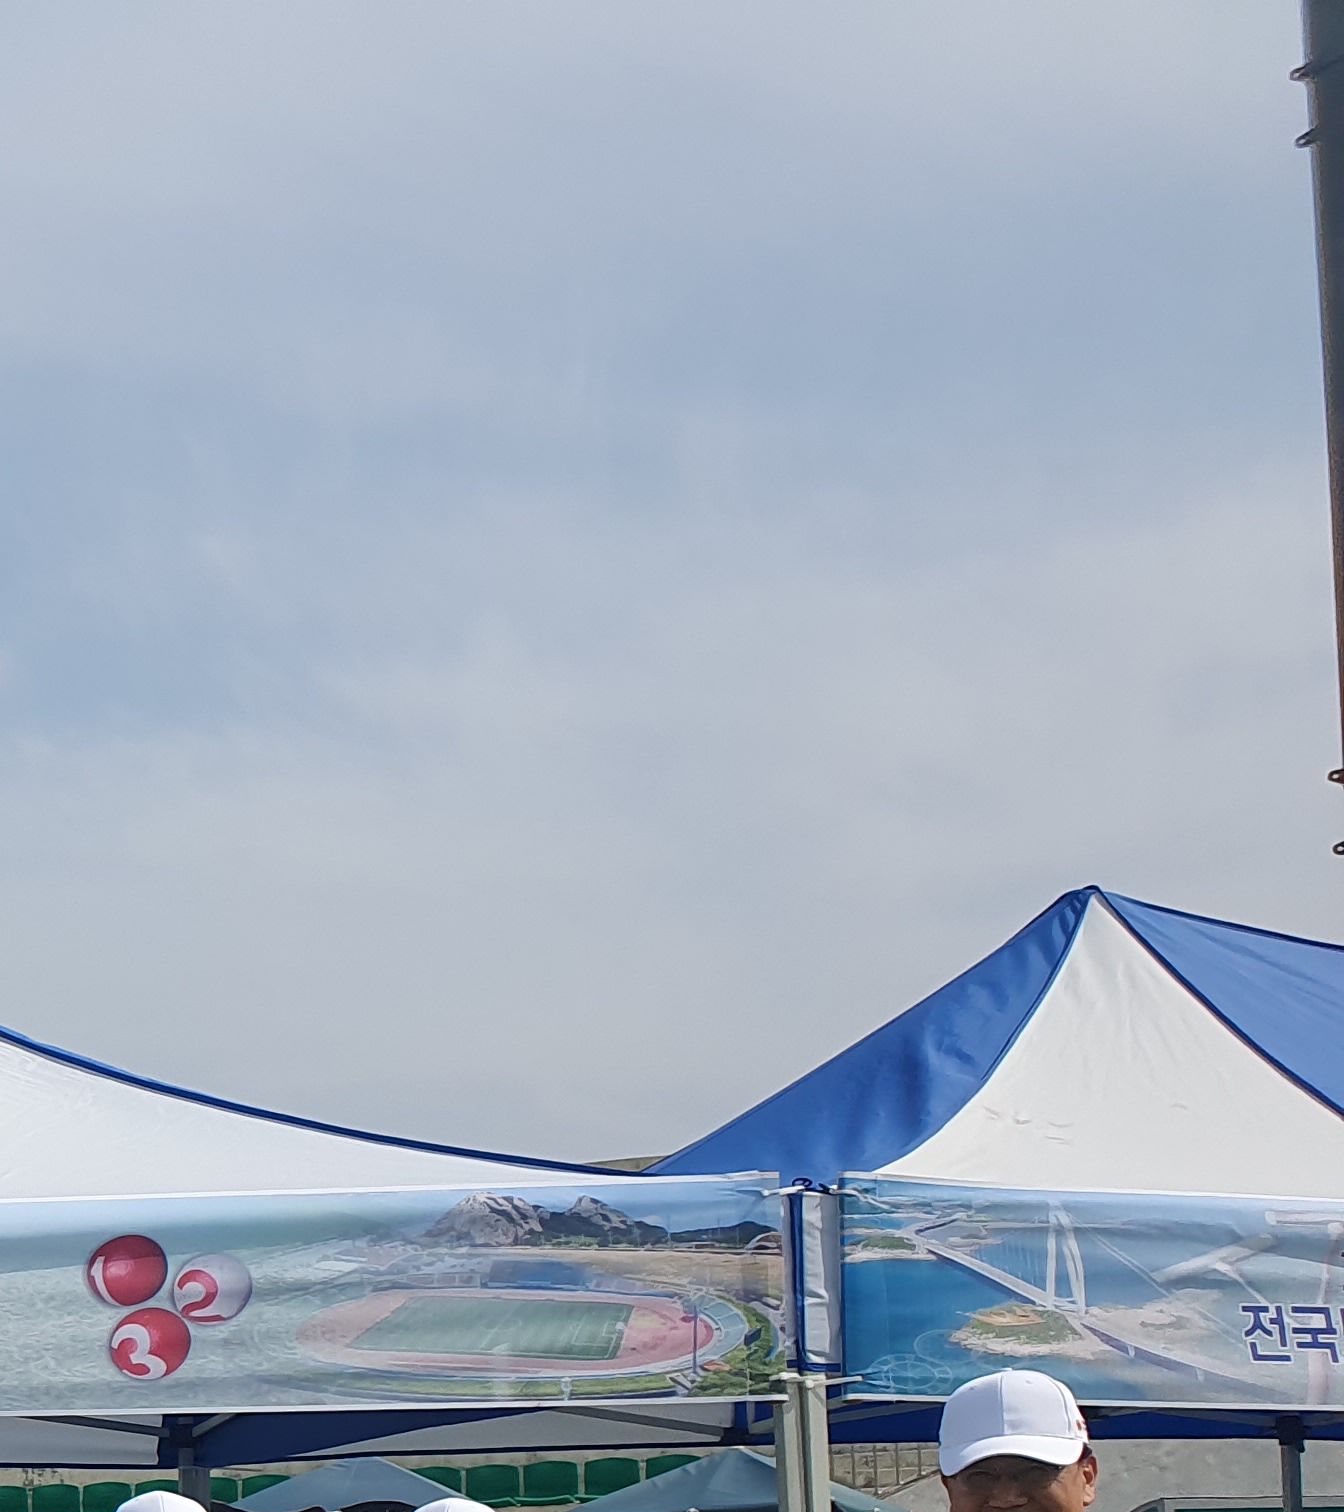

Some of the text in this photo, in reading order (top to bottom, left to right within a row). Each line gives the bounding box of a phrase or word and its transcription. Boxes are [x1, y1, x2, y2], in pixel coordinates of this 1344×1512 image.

[177, 1268, 227, 1323] 2
[110, 1322, 169, 1380] 3
[1240, 1304, 1344, 1363] 전국
